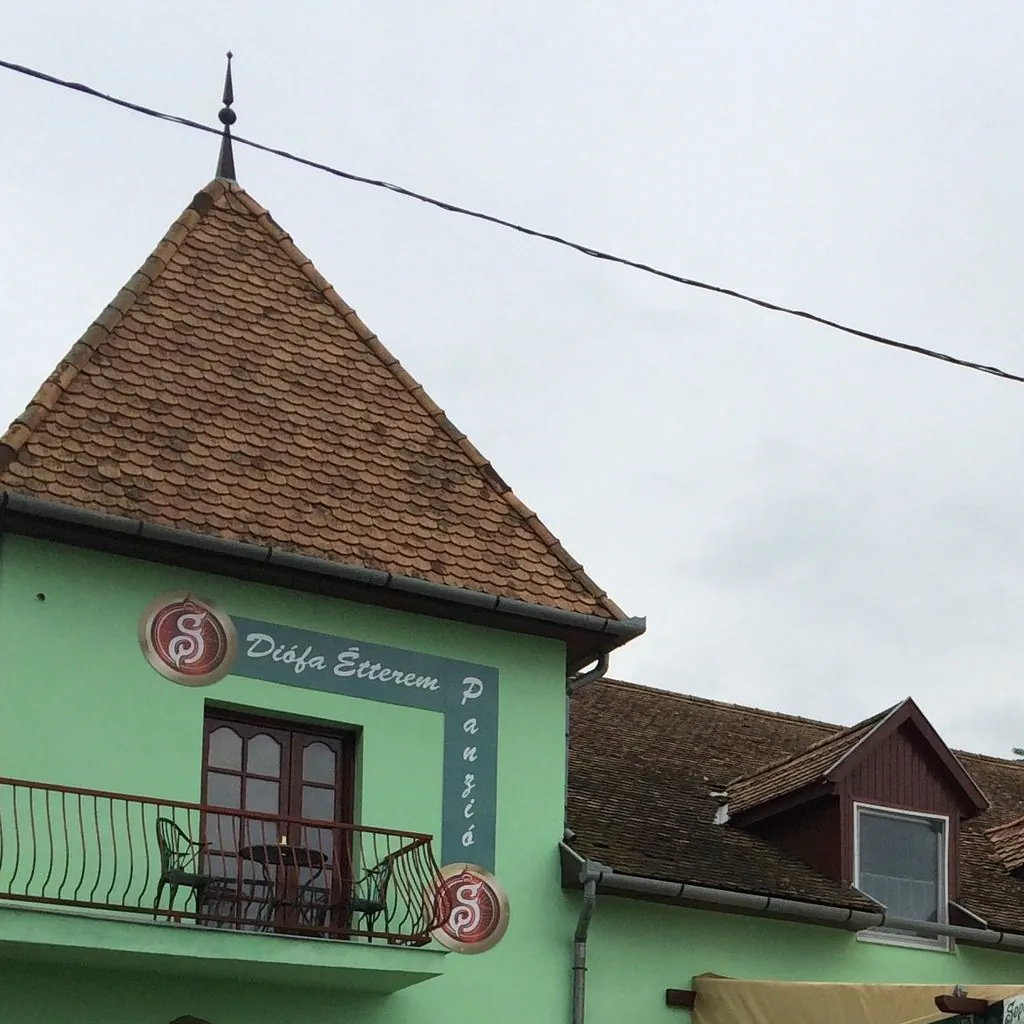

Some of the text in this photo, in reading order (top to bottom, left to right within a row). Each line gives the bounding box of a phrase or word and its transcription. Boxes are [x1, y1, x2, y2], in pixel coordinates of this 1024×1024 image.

[246, 633, 440, 691] Diófa Étterem
[461, 677, 484, 847] Panzió
